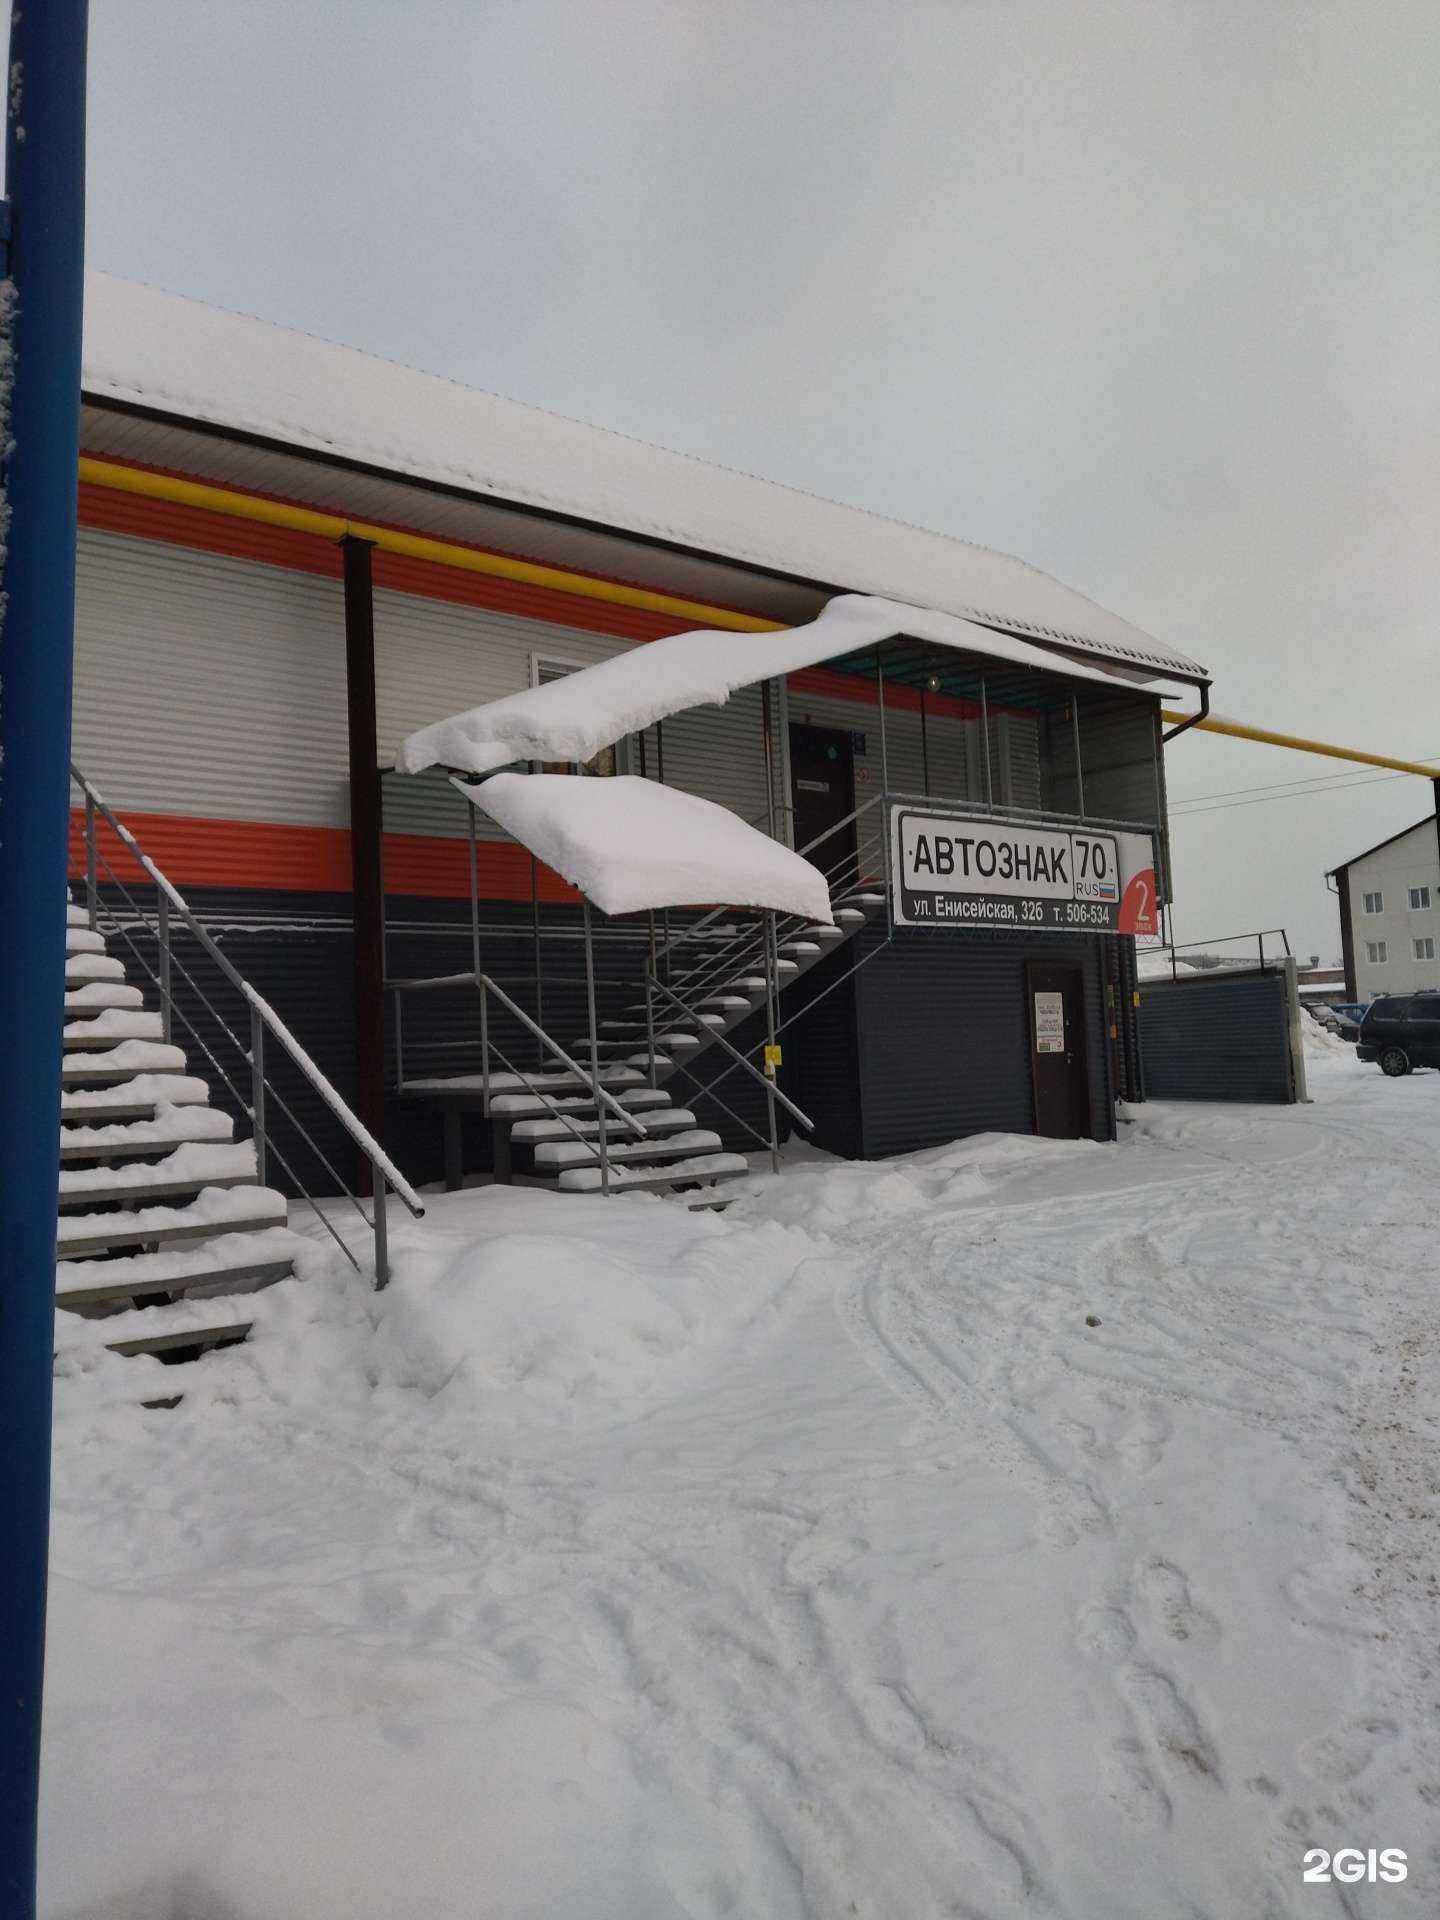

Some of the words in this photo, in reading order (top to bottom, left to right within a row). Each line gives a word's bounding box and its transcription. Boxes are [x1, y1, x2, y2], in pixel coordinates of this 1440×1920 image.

[913, 834, 1068, 884] АВТОЗНАК
[1075, 840, 1107, 879] 70
[1076, 881, 1099, 896] RUS
[1135, 880, 1150, 921] 2
[914, 900, 931, 916] ул.
[935, 896, 1019, 921] Енисейская,
[1053, 906, 1063, 922] т.
[1067, 903, 1109, 924] 506-534
